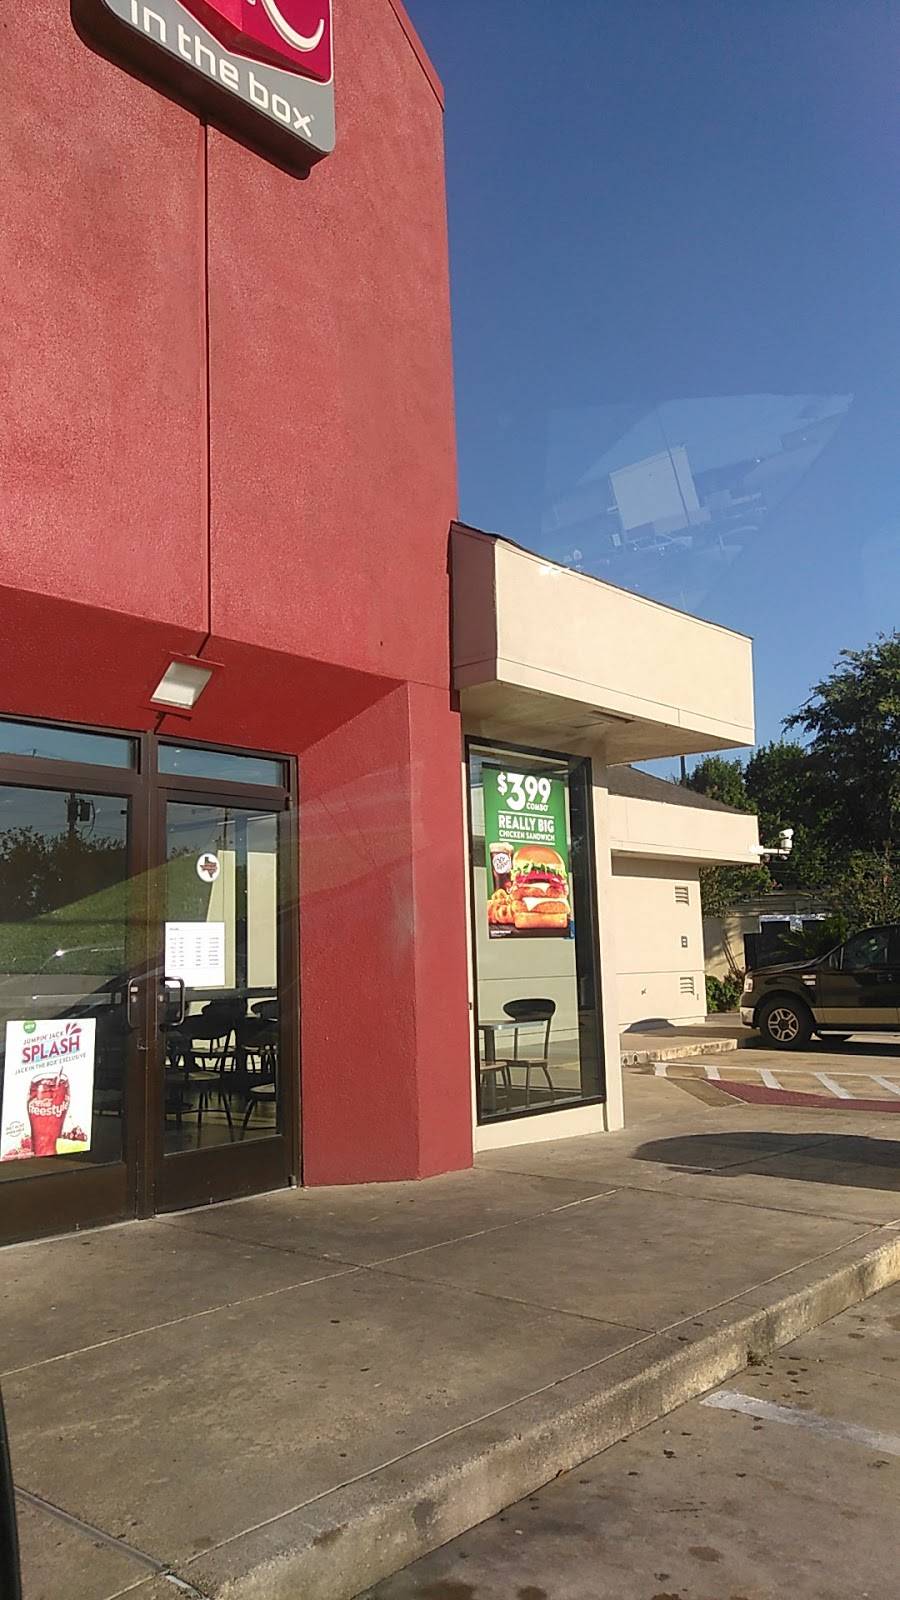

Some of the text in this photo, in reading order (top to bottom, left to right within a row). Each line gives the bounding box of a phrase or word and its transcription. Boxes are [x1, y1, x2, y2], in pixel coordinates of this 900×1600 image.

[131, 0, 167, 43] in
[177, 24, 240, 91] the
[249, 71, 312, 138] box
[498, 814, 555, 833] REALLY BIG
[498, 829, 555, 841] CHICKEN SANDWICH
[22, 1035, 80, 1063] SPLASH
